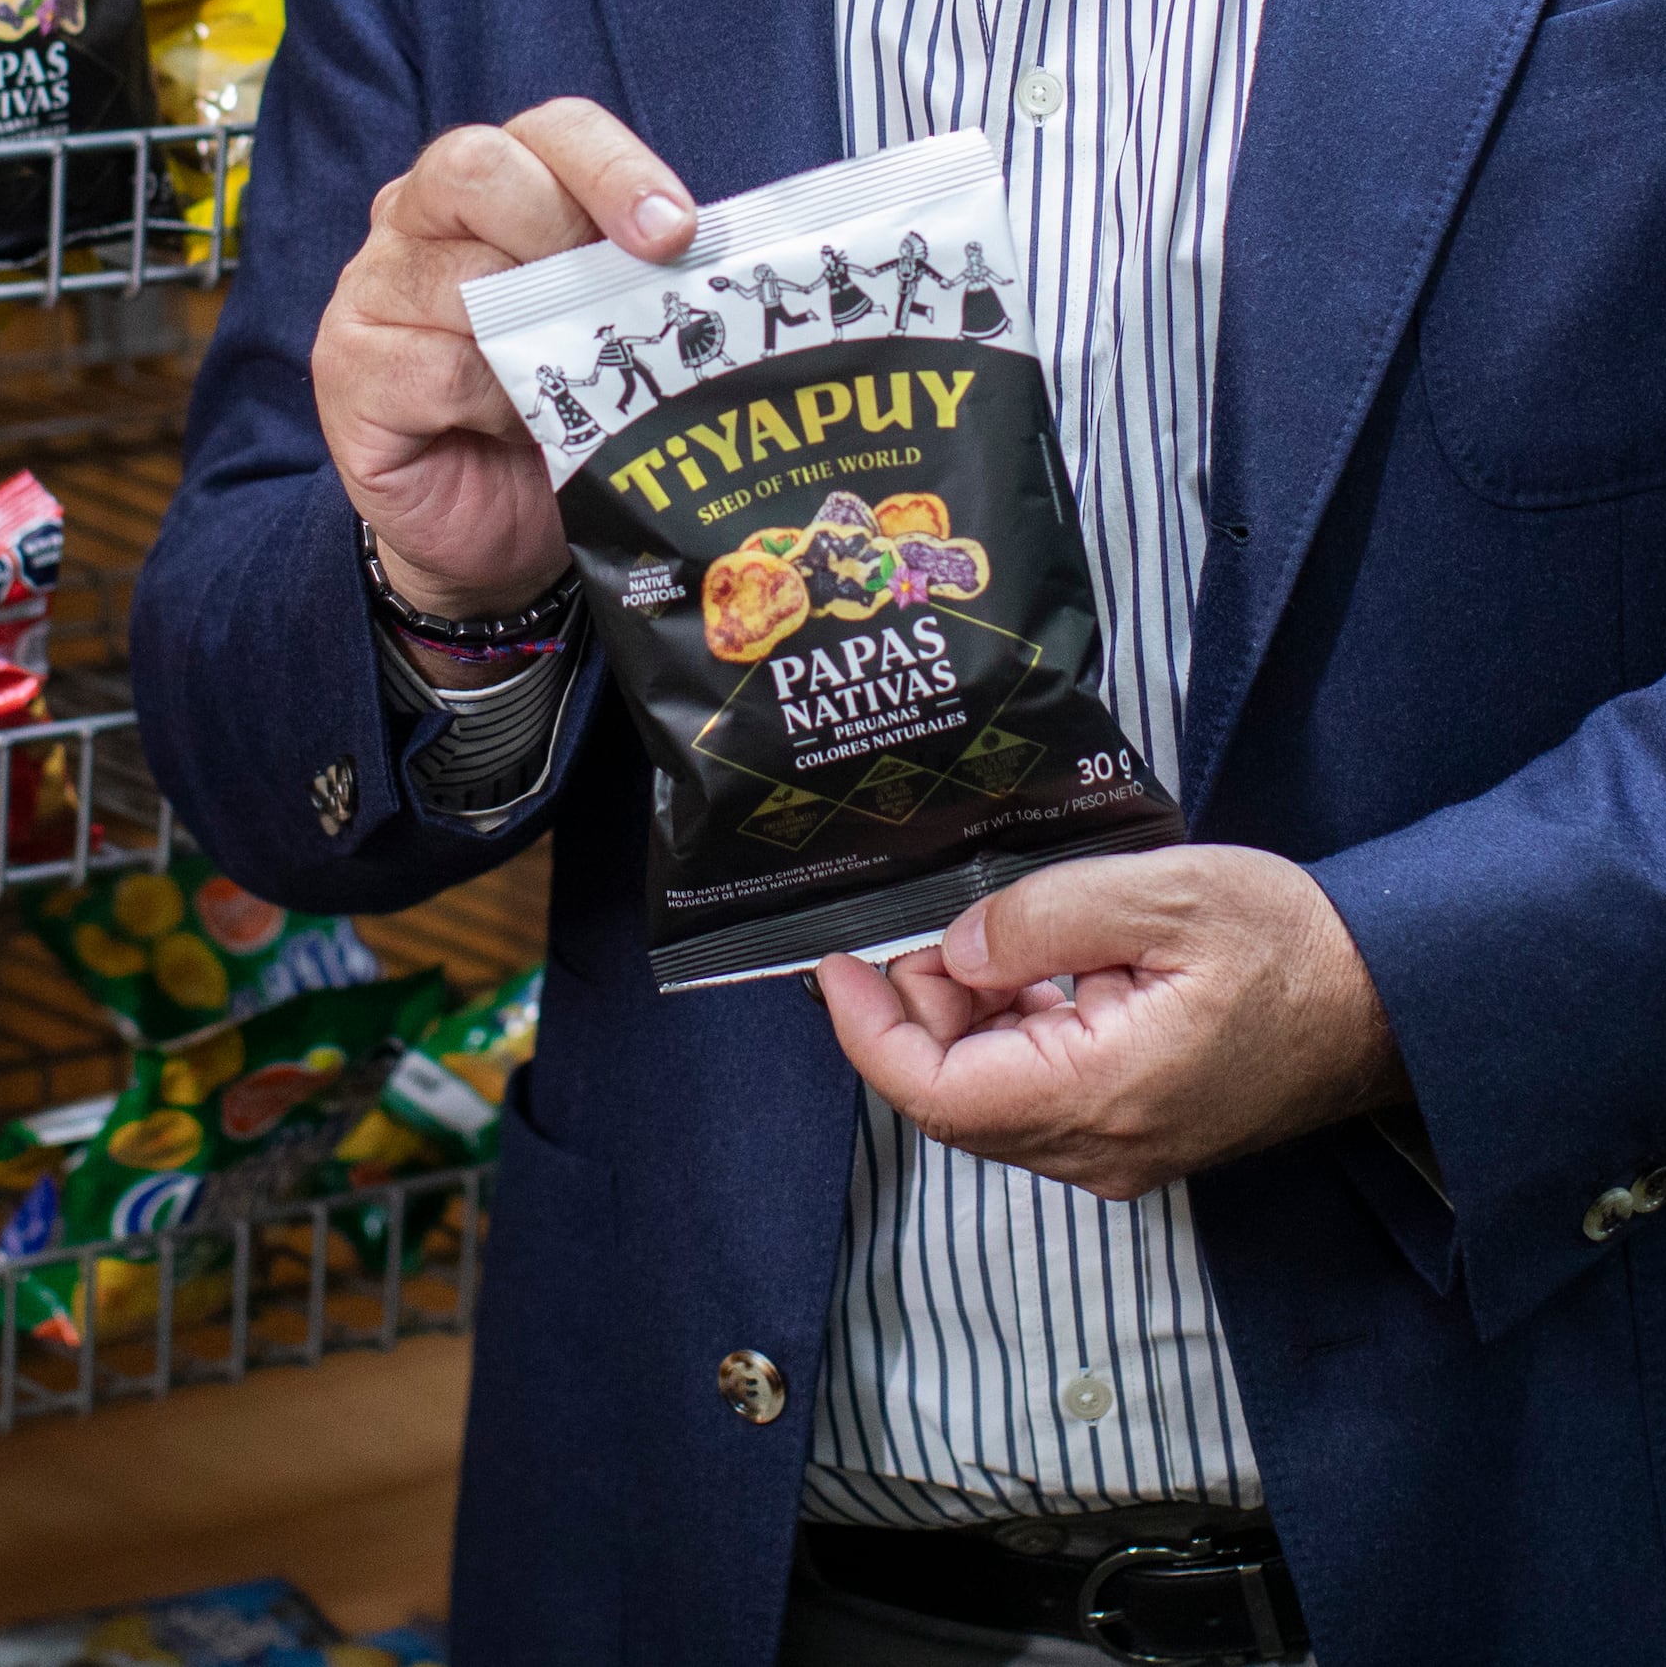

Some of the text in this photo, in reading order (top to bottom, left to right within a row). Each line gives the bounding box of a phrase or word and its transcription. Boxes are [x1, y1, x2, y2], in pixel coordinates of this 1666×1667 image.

[608, 369, 976, 513] TiYAPUY
[697, 446, 923, 526] SEED OF THE WORLD
[621, 584, 687, 608] POTATOES
[628, 564, 671, 579] MADE WITH
[629, 573, 673, 593] NATIVE
[768, 615, 947, 701] PAPAS
[780, 659, 958, 735] NATIVAS
[834, 704, 921, 740] PERUANAS
[795, 710, 968, 770] COLORES NATURALES
[1077, 747, 1133, 785] 30 g
[963, 820, 989, 838] NET
[990, 812, 1014, 829] WT.
[1016, 808, 1044, 822] 1.06
[1044, 806, 1061, 820] oz
[1071, 792, 1108, 813] PESO
[1109, 780, 1145, 804] NETO
[666, 854, 859, 900] FRIED NATIVE POTATO CHIPS WITH SALT
[667, 853, 892, 909] HOJUELAS DE PAPAS NATIVAS FRITAS CON SAL
